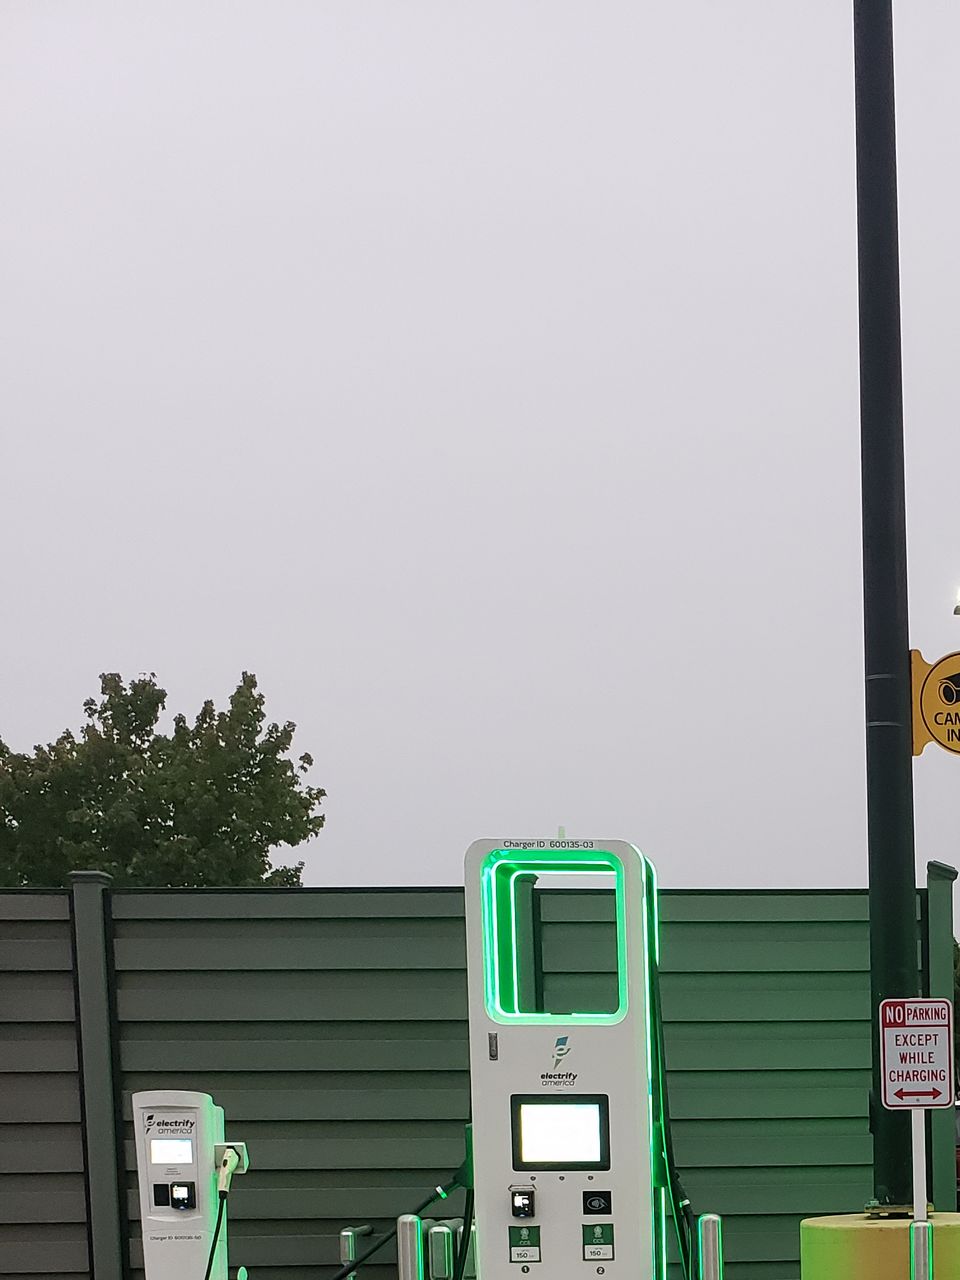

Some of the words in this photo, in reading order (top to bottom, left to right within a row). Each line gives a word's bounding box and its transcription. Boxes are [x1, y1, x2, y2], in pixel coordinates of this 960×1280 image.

[947, 728, 960, 742] IN
[503, 840, 535, 850] Charger
[536, 840, 546, 848] ID
[549, 840, 594, 849] 600135-03
[886, 1005, 904, 1024] NO
[906, 1007, 947, 1021] PARKING
[895, 1033, 939, 1047] EXCEPT
[899, 1051, 935, 1065] WHILE
[540, 1072, 578, 1081] electrify
[889, 1069, 946, 1083] CHARGING
[156, 1119, 195, 1129] electrify
